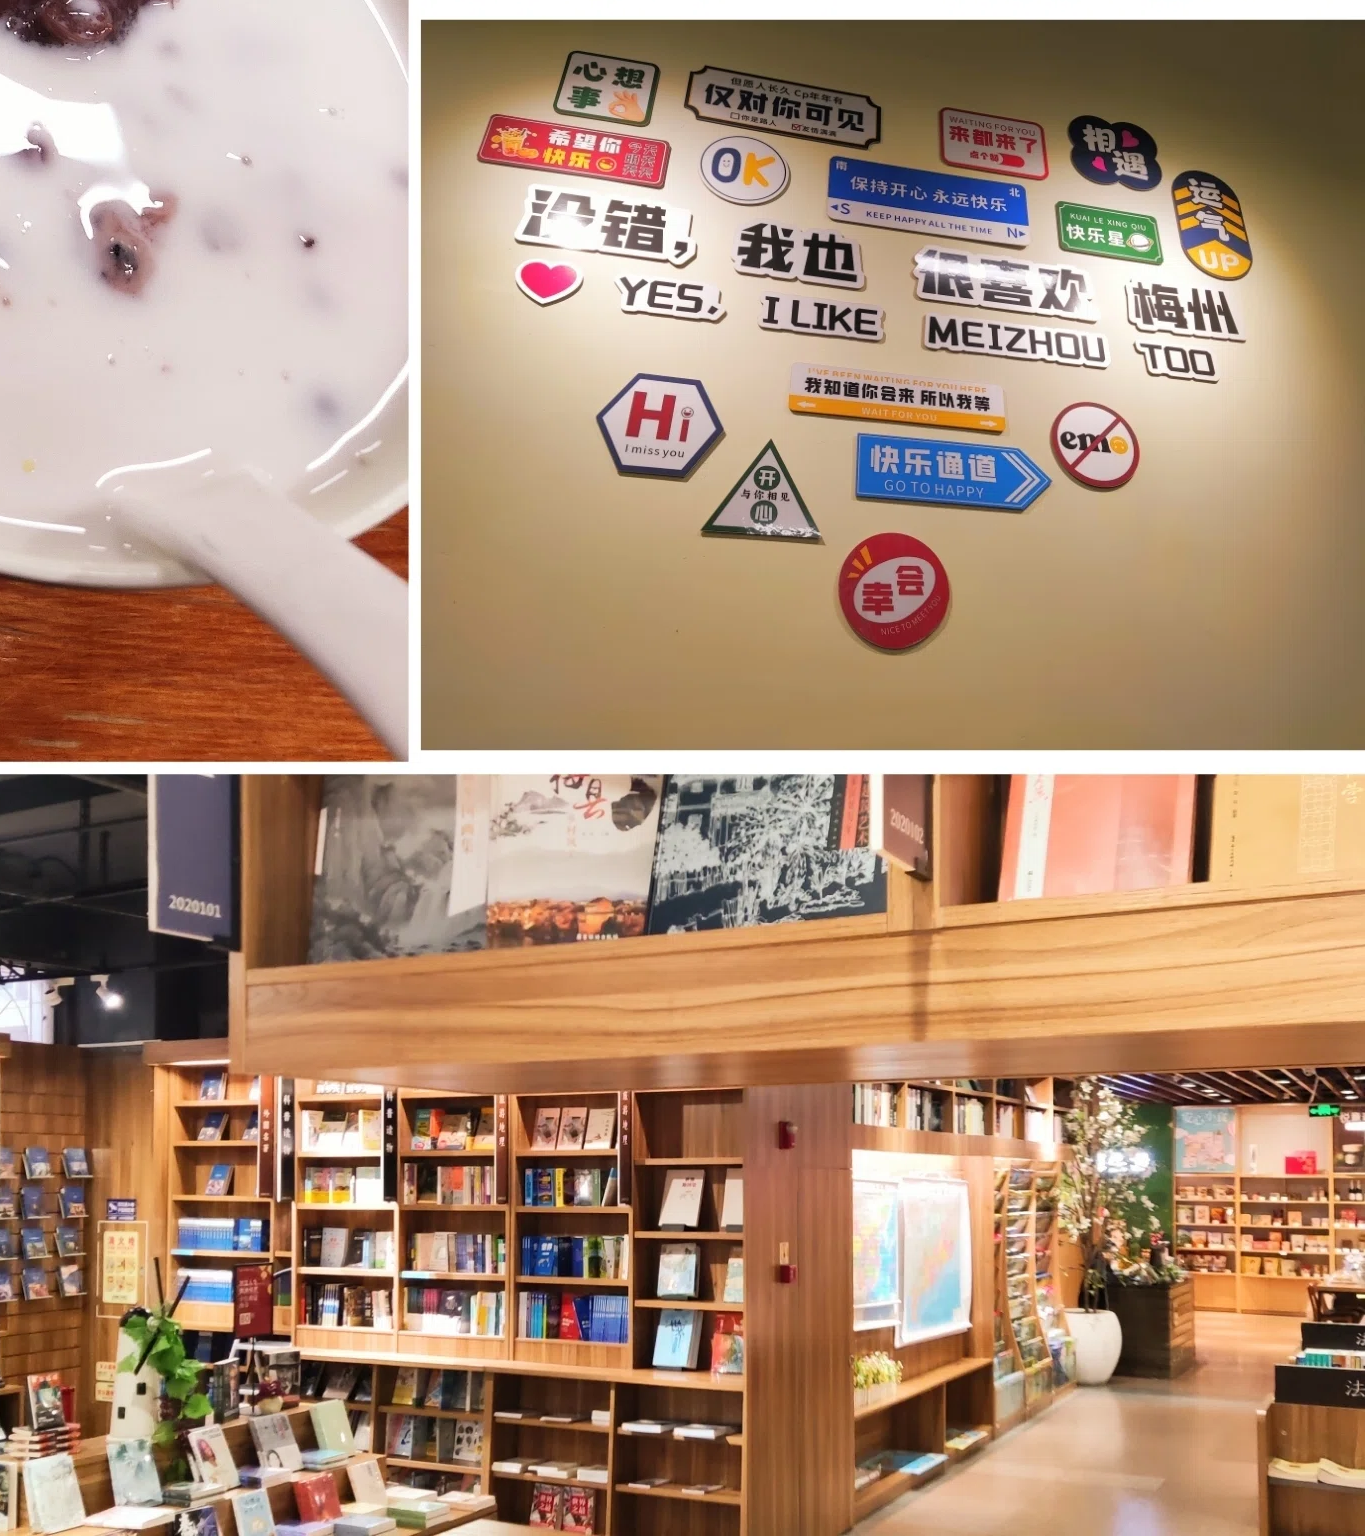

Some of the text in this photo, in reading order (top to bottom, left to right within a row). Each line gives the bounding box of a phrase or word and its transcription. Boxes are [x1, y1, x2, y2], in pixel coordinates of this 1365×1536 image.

[572, 61, 646, 90] 心想
[567, 85, 603, 109] 事
[704, 83, 866, 134] 仅对你可见
[949, 115, 1037, 138] WAITING FOR YOU
[949, 125, 1038, 154] 来都来了
[547, 127, 623, 155] 希望你
[541, 147, 593, 170] 快乐
[711, 147, 776, 188] OK
[850, 175, 1008, 213] 保持开心 永远快乐
[1008, 186, 1021, 198] 北
[840, 202, 1018, 239] S KEEP HAPPY ALL THE TIME N
[1069, 212, 1148, 233] KUAI LE XING QIU
[1065, 223, 1127, 248] 快乐星
[1197, 248, 1240, 272] UP
[735, 221, 1240, 336] 我也 很喜欢 梅州
[762, 295, 780, 325] I
[789, 300, 879, 337] LIKE
[928, 316, 1107, 364] MEIZHOU
[1143, 343, 1215, 377] TOO
[804, 376, 991, 412] 我知道你会来 所以我等
[624, 390, 695, 443] Hi
[861, 407, 938, 422] WAIT FOR YOU
[631, 445, 685, 459] miss you
[870, 444, 997, 483] 快乐通道
[740, 489, 790, 502] 与你相见
[884, 479, 984, 499] GO TO HAPPY
[880, 595, 941, 636] NICE TO MEET YOU
[889, 808, 925, 845] 2020102
[168, 894, 223, 920] 2020101
